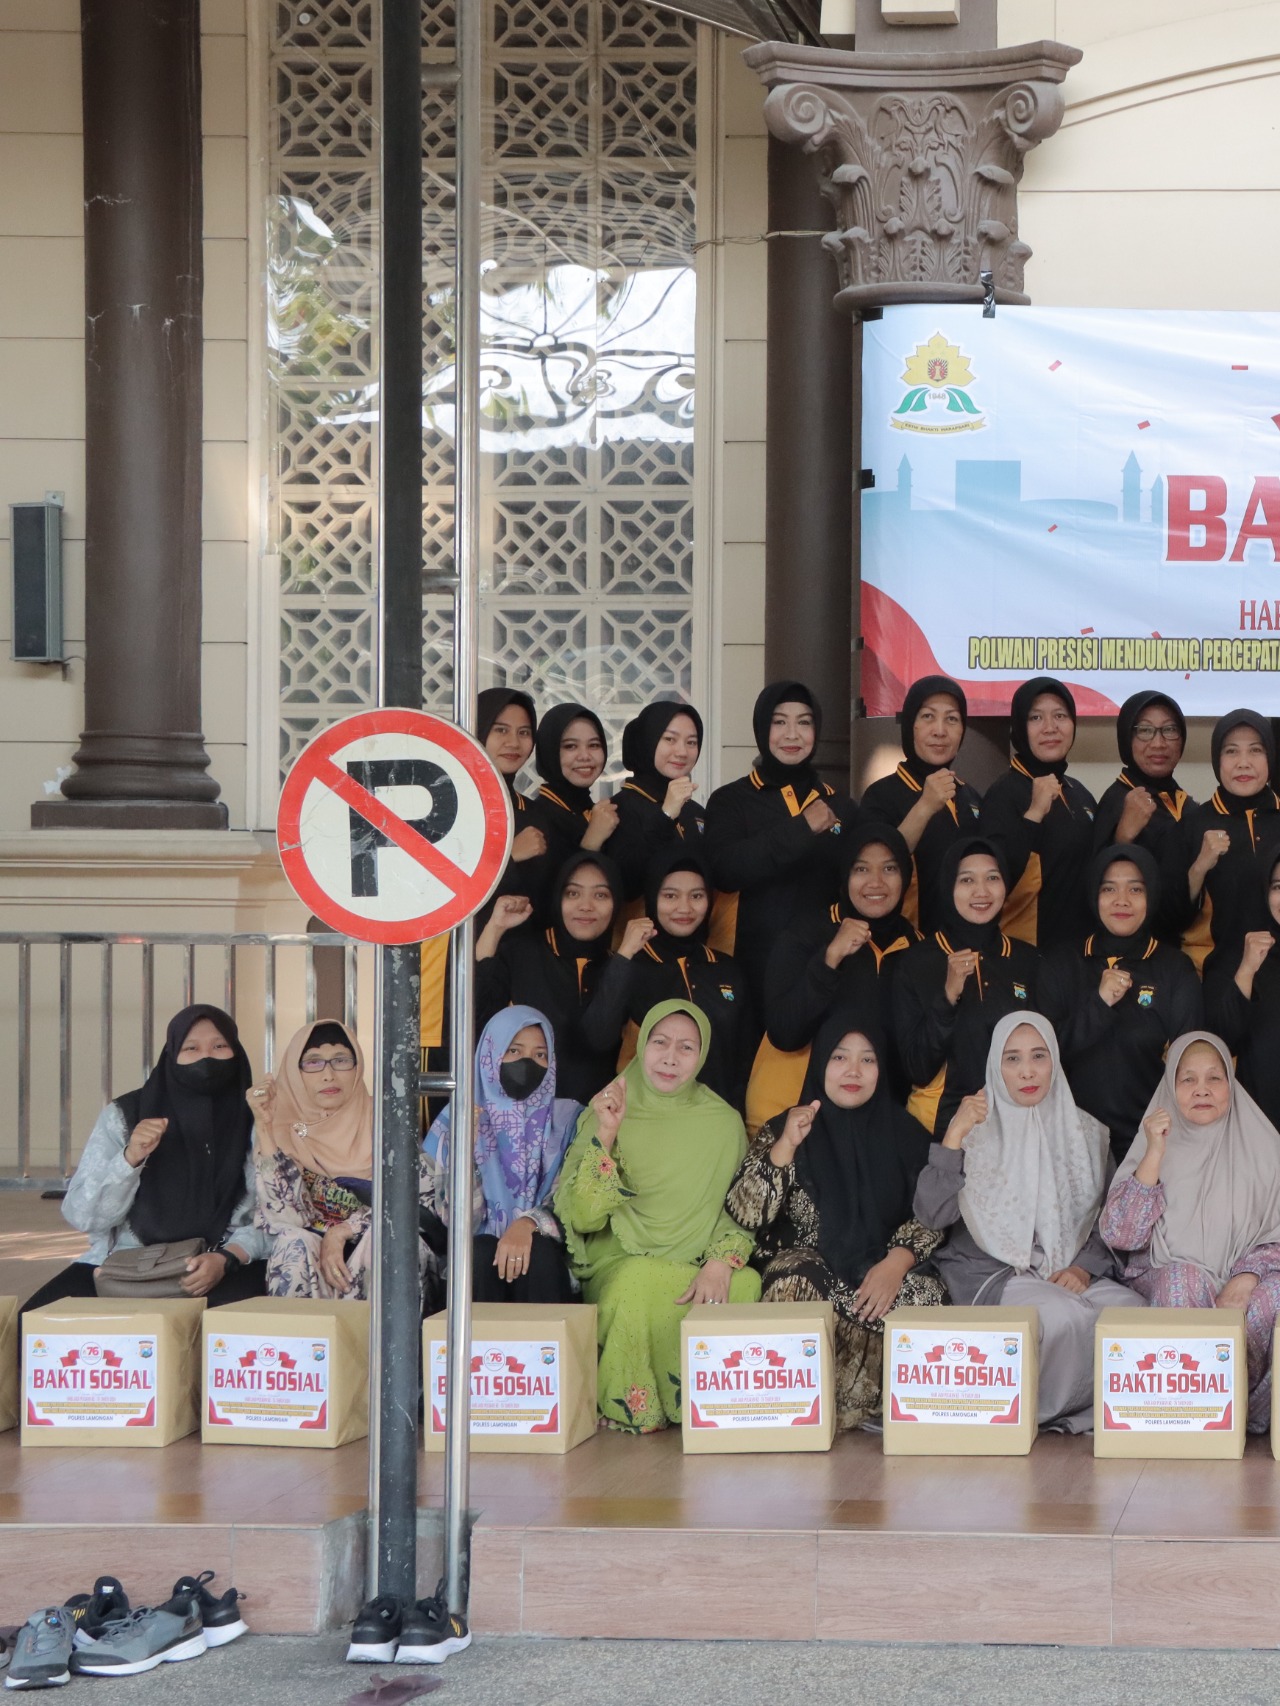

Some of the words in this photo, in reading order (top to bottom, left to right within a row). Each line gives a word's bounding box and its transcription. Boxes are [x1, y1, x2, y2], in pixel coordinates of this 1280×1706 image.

[968, 636, 1035, 669] POLWAN
[1036, 637, 1099, 670] PRESISI
[1101, 637, 1201, 671] MENDUKUNG
[347, 759, 458, 897] P
[87, 1347, 99, 1356] 76
[264, 1348, 275, 1357] 76
[750, 1347, 762, 1356] 76
[952, 1343, 964, 1352] 76
[1164, 1351, 1176, 1359] 76
[490, 1353, 502, 1362] 76
[33, 1369, 85, 1388] BAKTI
[90, 1370, 151, 1389] SOSIAL
[215, 1368, 262, 1389] BAKTI
[266, 1371, 324, 1392] SOSIAL
[696, 1371, 748, 1390] BAKTI
[754, 1369, 816, 1389] SOSIAL
[897, 1364, 949, 1385] BAKTI
[954, 1366, 1016, 1386] SOSIAL
[1110, 1373, 1162, 1393] BAKTI
[1167, 1373, 1229, 1393] SOSIAL
[438, 1376, 488, 1395] BTI
[494, 1376, 554, 1395] SOSIAL
